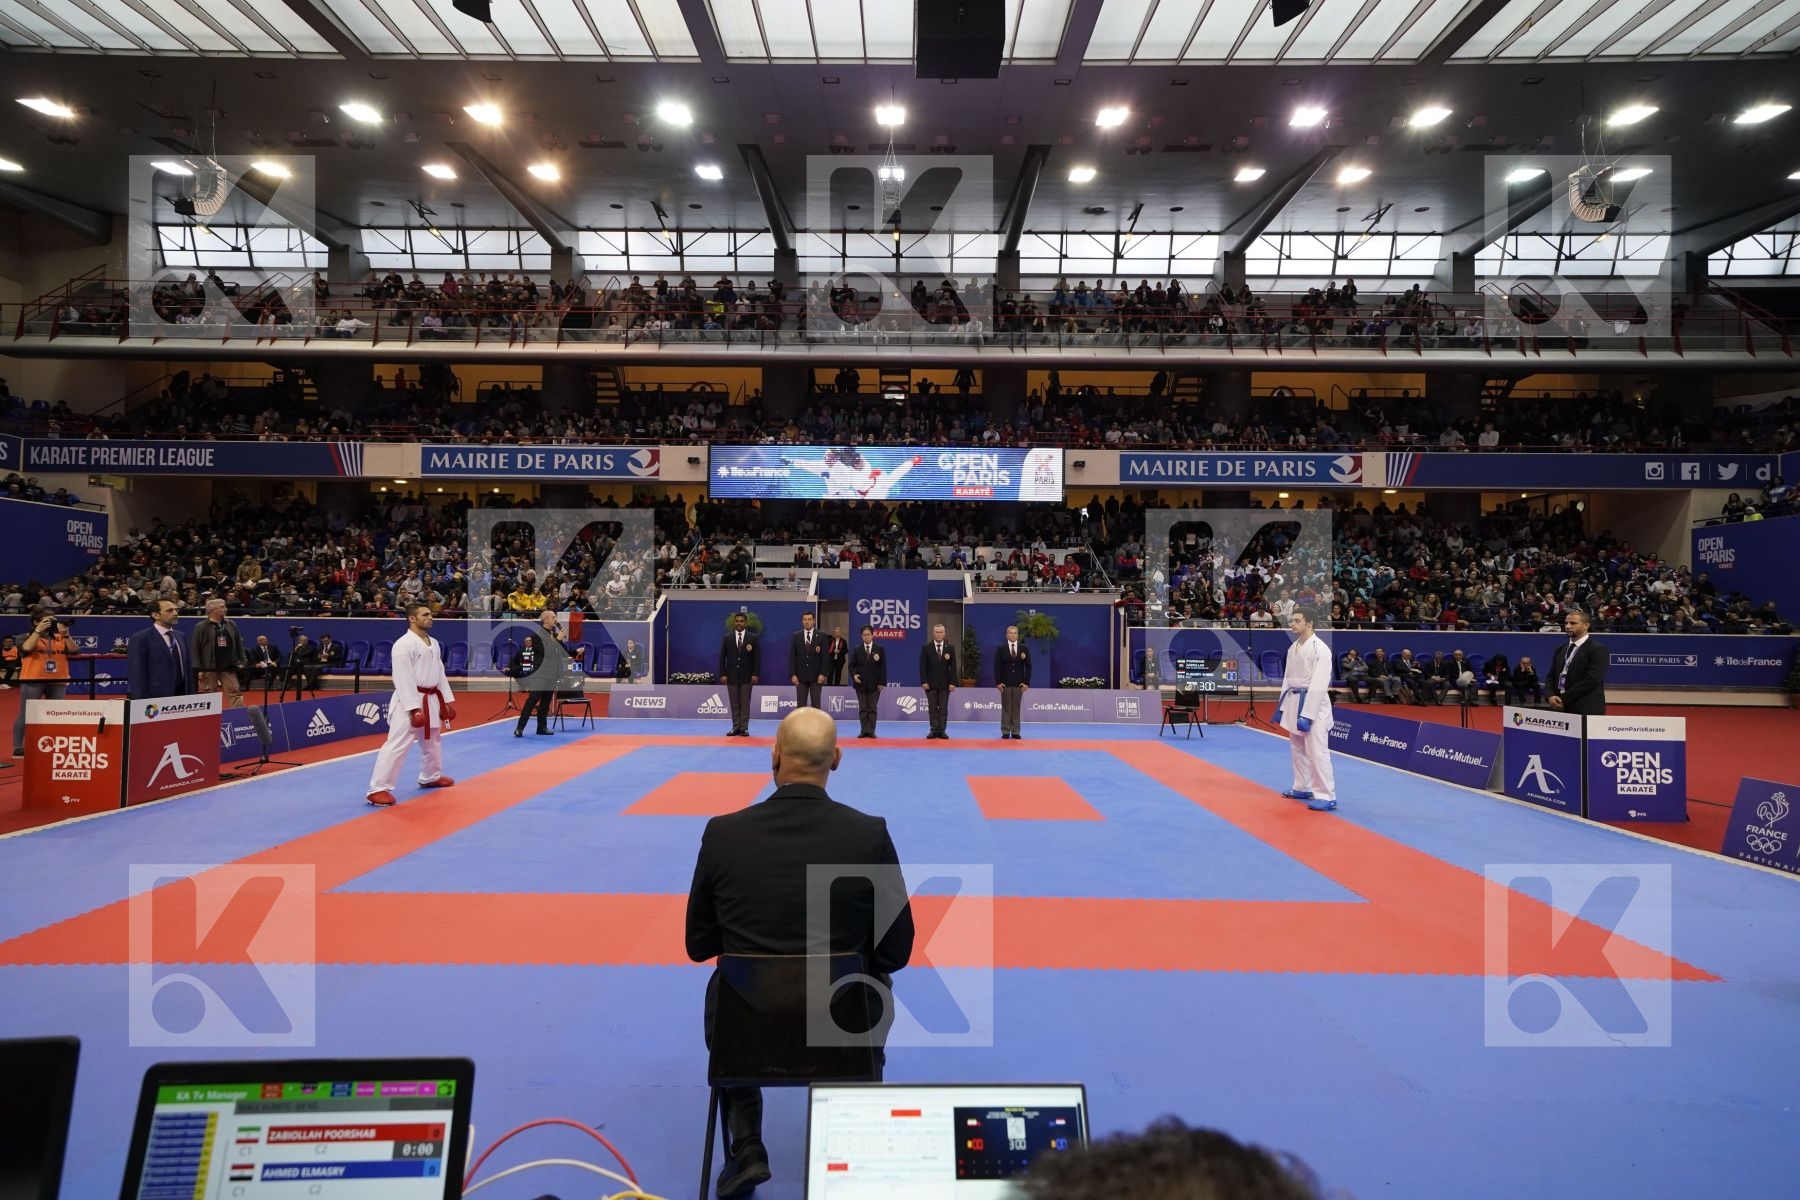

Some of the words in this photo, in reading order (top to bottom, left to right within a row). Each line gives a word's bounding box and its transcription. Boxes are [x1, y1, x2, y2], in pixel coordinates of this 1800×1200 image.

[30, 446, 87, 466] KARATE
[91, 446, 156, 468] PREMIER
[159, 448, 214, 468] LEAGUE
[430, 452, 509, 469] MAIRIE
[517, 453, 545, 470] DE
[553, 453, 614, 470] PARIS
[938, 453, 998, 470] OPEN
[1129, 459, 1209, 477] MAIRIE
[1216, 460, 1246, 477] DE
[1254, 460, 1316, 477] PARIS
[953, 470, 1011, 486] PARIS
[67, 520, 93, 535] OPEN
[75, 534, 103, 549] PARIS
[1698, 536, 1723, 551] OPEN
[1706, 548, 1735, 564] PARIS
[856, 598, 910, 615] OPEN
[870, 614, 920, 629] PARIS
[1617, 656, 1645, 664] MAIRIE
[697, 704, 728, 715] adidas
[306, 724, 336, 737] adidas
[38, 735, 97, 753] OPEN
[52, 753, 109, 769] PARIS
[1422, 744, 1446, 759] Crédit
[1453, 751, 1483, 766] Mutuel
[1601, 750, 1661, 769] OPEN
[55, 770, 89, 779] KARATÉ
[1616, 768, 1674, 785] PARIS
[1620, 785, 1654, 793] KARATÉ
[1746, 824, 1788, 841] FRANCE
[206, 1089, 248, 1103] Manager
[402, 1142, 434, 1157] 0:00
[263, 1167, 299, 1179] AHMED
[301, 1166, 346, 1178] ELMASRY
